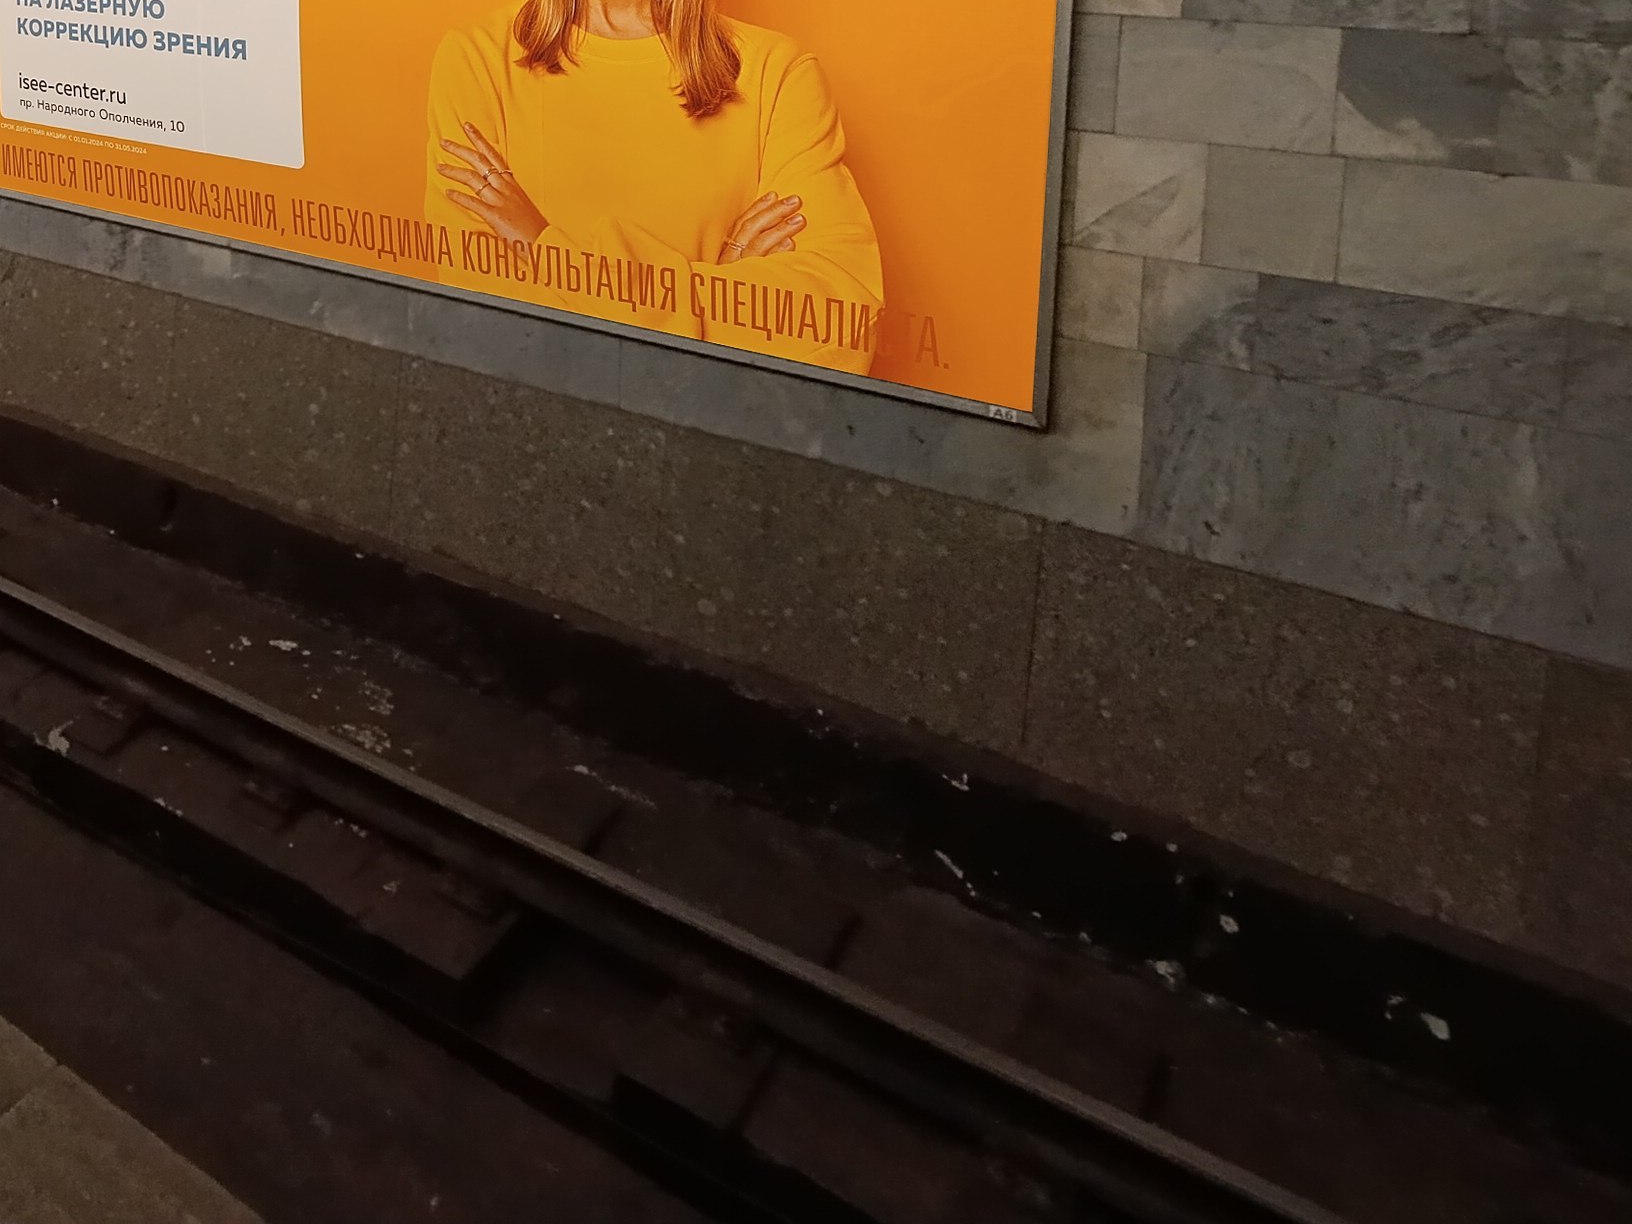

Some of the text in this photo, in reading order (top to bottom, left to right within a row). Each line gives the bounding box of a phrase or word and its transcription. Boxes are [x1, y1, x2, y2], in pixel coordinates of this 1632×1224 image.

[16, 17, 248, 61] КОРРЕКЦИЮ ЗРЕНИЯ
[18, 72, 127, 105] isee-center.ru
[19, 98, 185, 133] пр. Народного Ополчения, 10
[0, 122, 15, 130] СРОК
[104, 141, 114, 149] ПО
[1, 143, 950, 370] ИМЕЮТСЯ ПРОТИВОПОКАЗАНИЯ, НЕОБХОДИМА КОНСУЛЬТАЦИЯ СПЕЦИАЛИТА.
